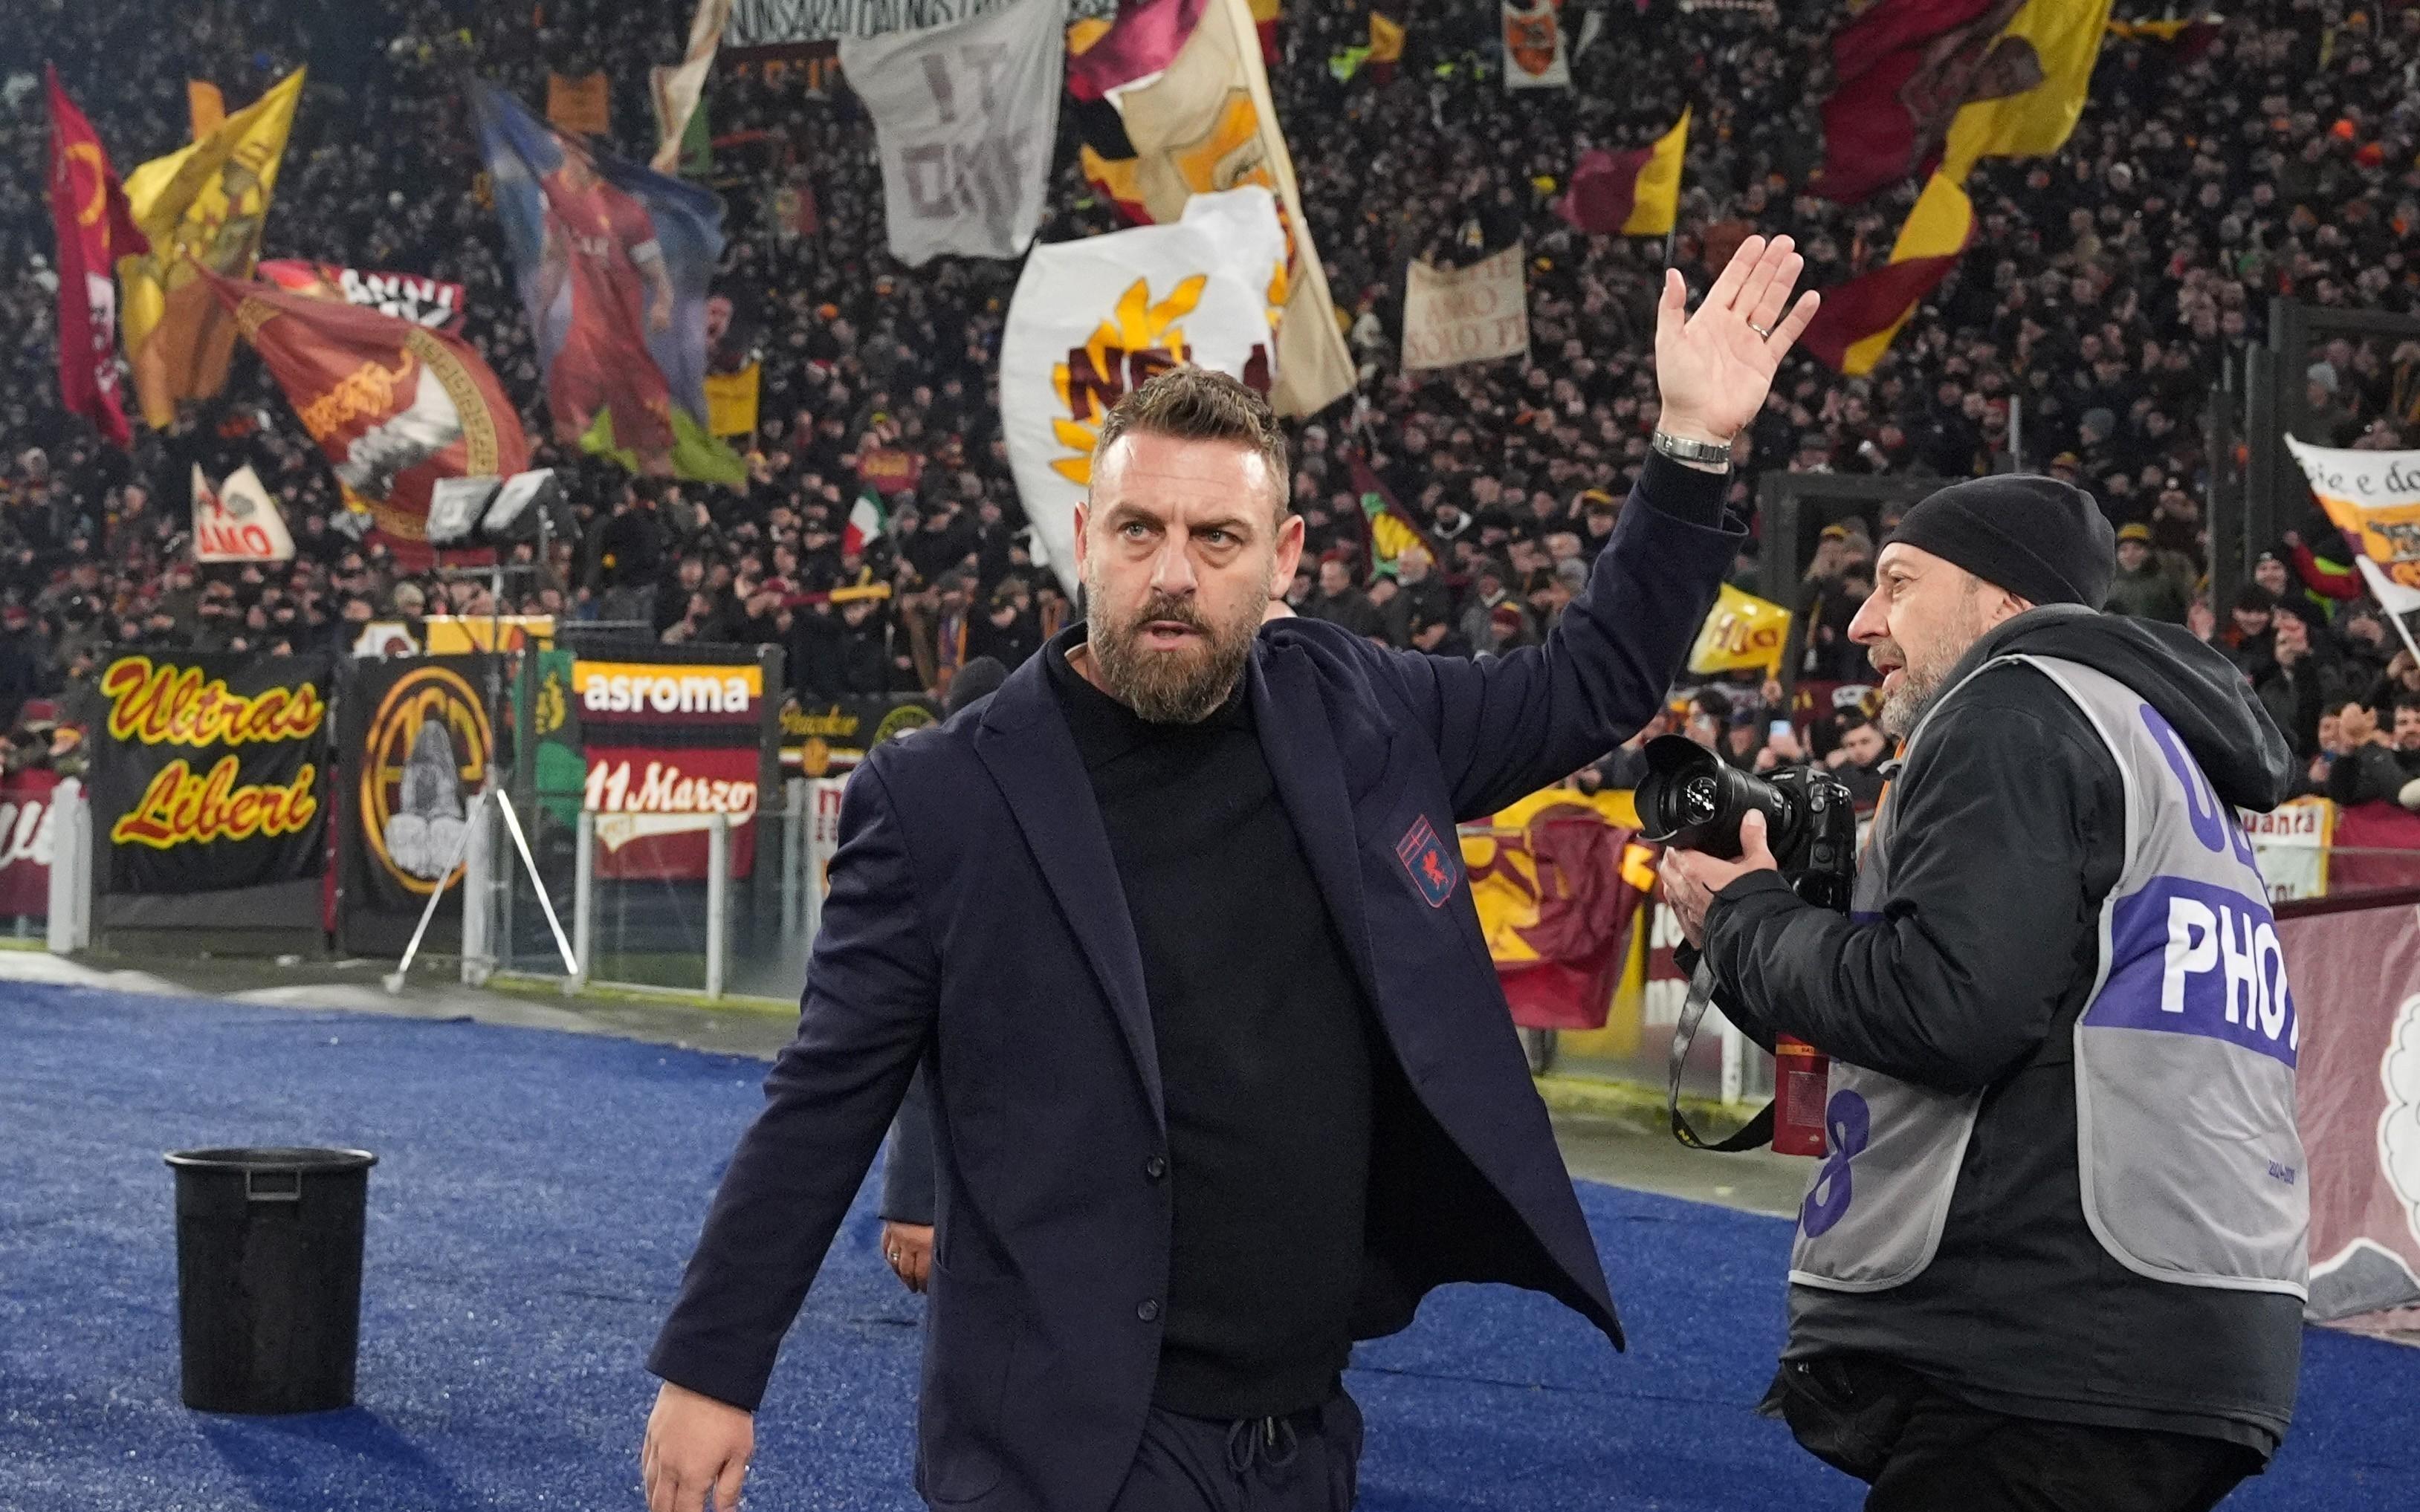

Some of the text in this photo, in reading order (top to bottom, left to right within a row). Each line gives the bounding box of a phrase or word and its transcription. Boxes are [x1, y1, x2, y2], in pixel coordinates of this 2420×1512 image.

[101, 656, 324, 747] Ultras
[584, 674, 749, 713] asroma
[111, 756, 317, 849] Liberi
[584, 759, 758, 813] 11 Marzo
[2161, 897, 2299, 1051] PHO
